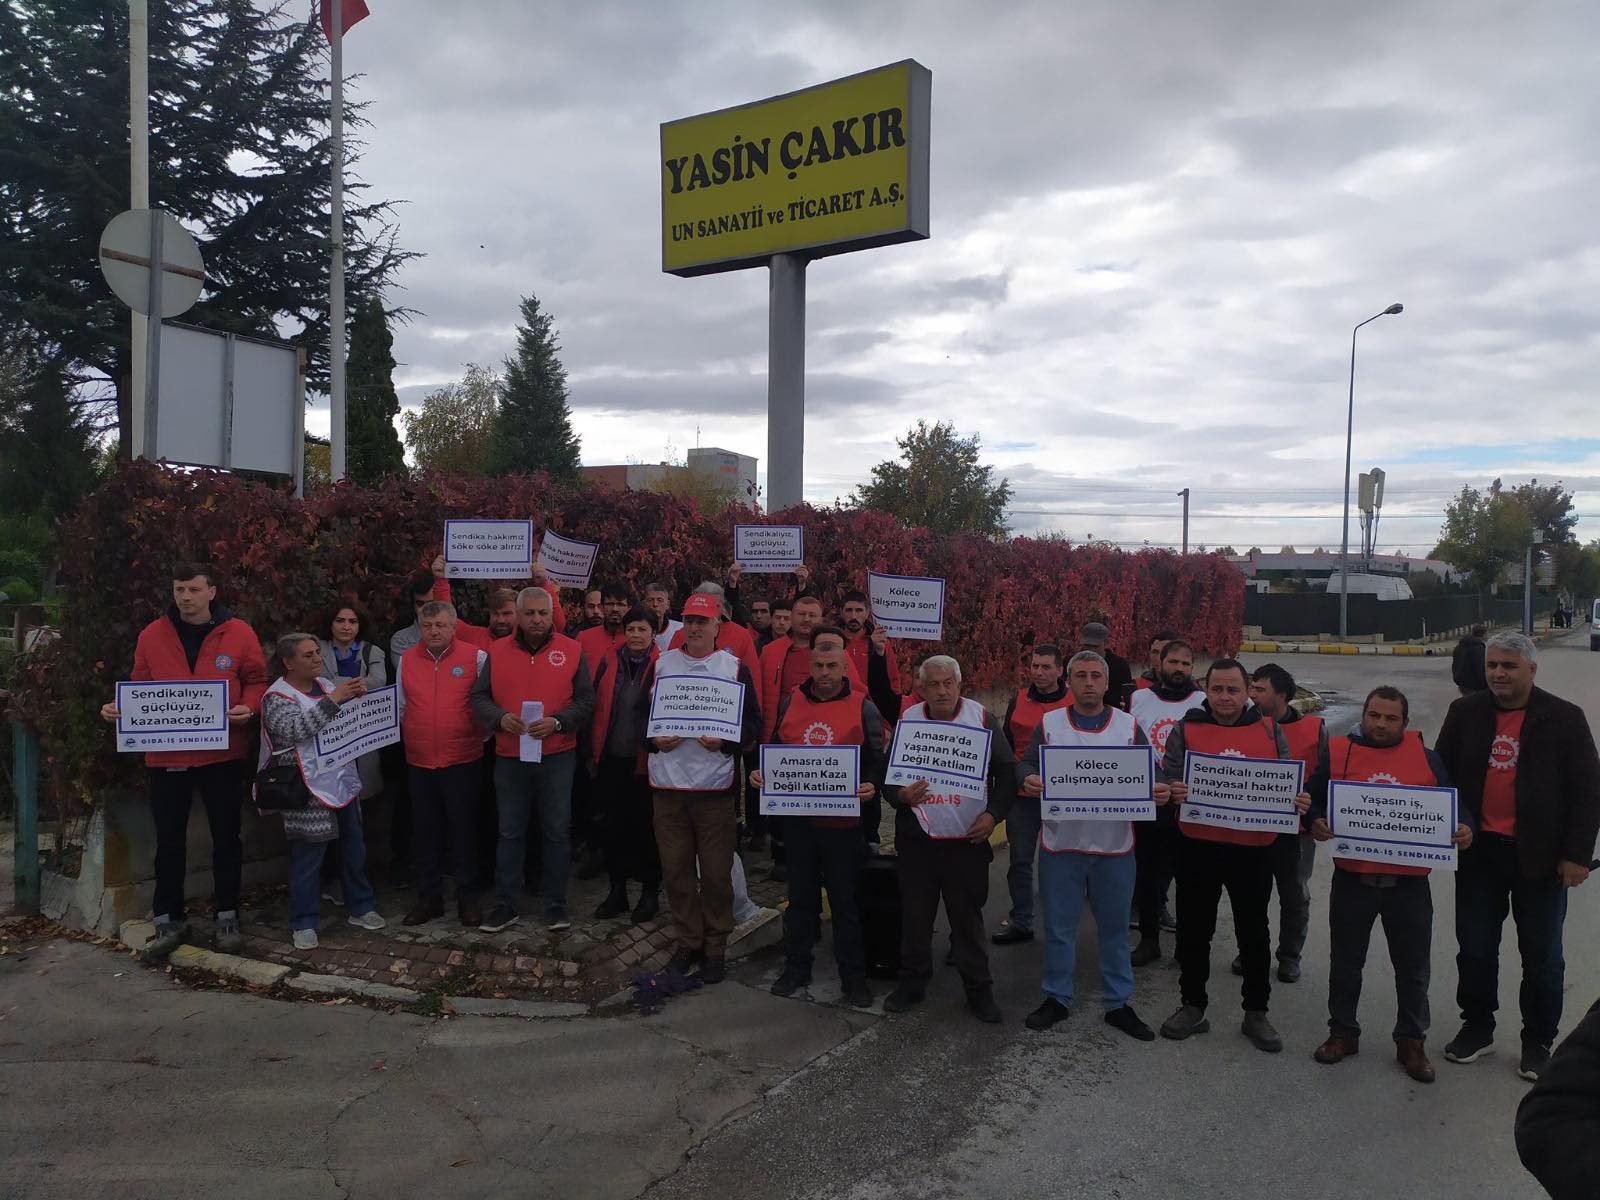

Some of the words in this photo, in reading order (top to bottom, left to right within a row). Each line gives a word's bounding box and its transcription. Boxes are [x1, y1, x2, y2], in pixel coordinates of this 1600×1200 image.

[666, 135, 771, 194] YASİN
[780, 107, 906, 180] ÇAKIR
[671, 221, 694, 242] UN
[766, 209, 784, 225] ve
[788, 190, 865, 222] TİCARET
[869, 182, 905, 208] A.Ş.
[744, 530, 794, 538] Sendikalıyız,
[500, 543, 524, 551] alırız!
[750, 540, 789, 548] güçlüyüz,
[548, 554, 565, 563] söke
[557, 548, 590, 560] hakkımız
[889, 587, 921, 597] Kölece
[918, 602, 937, 610] son!
[131, 688, 213, 700] Sendikalıyız,
[675, 684, 709, 692] Yaşasın
[711, 685, 720, 695] iş,
[659, 693, 692, 702] ekmek,
[694, 695, 735, 706] özgürlük
[141, 702, 204, 714] güçlüyüz,
[328, 705, 360, 722] endikalı
[361, 695, 392, 708] olmak
[663, 704, 728, 714] mücadelemiz!
[131, 715, 215, 726] kazanacağız!
[322, 715, 359, 736] anayasal
[360, 705, 391, 719] haktır!
[323, 726, 358, 746] Hakkımız
[359, 715, 392, 730] tanınsın
[697, 725, 736, 735] SENDİKASI
[141, 737, 175, 745] GIDA-İŞ
[178, 736, 223, 744] SENDİKASI
[913, 731, 972, 746] Amasra'da
[904, 743, 949, 755] Yaşanan
[952, 749, 978, 761] Kaza
[780, 757, 839, 766] Amasra'da
[902, 754, 930, 765] Değil
[932, 757, 976, 773] Katliam
[1075, 760, 1119, 770] Kölece
[772, 769, 818, 780] Yaşanan
[820, 770, 847, 779] Kaza
[1193, 763, 1251, 777] Sendikalı
[1254, 769, 1295, 781] olmak
[940, 779, 981, 792] SENDİKASI
[1050, 774, 1114, 786] çalışmaya
[1117, 774, 1145, 784] son!
[1193, 777, 1248, 790] anayasal
[1251, 782, 1293, 793] haktır!
[773, 781, 800, 792] Değil
[803, 782, 847, 792] Katliam
[1192, 787, 1244, 801] Hakkımız
[1247, 794, 1292, 804] tanınsın
[1360, 794, 1407, 806] Yaşasın
[1410, 797, 1423, 809] iş,
[1065, 805, 1100, 814] GIDA-İŞ
[1340, 806, 1386, 819] ekmek,
[1388, 810, 1445, 823] özgürlük
[1205, 812, 1241, 823] GIDA-İŞ
[1245, 817, 1294, 826] SENDİKASI
[1348, 819, 1436, 835] mücadelemiz!
[1355, 846, 1394, 857] GIDA-İŞ
[1397, 849, 1451, 861] SENDİKASI
